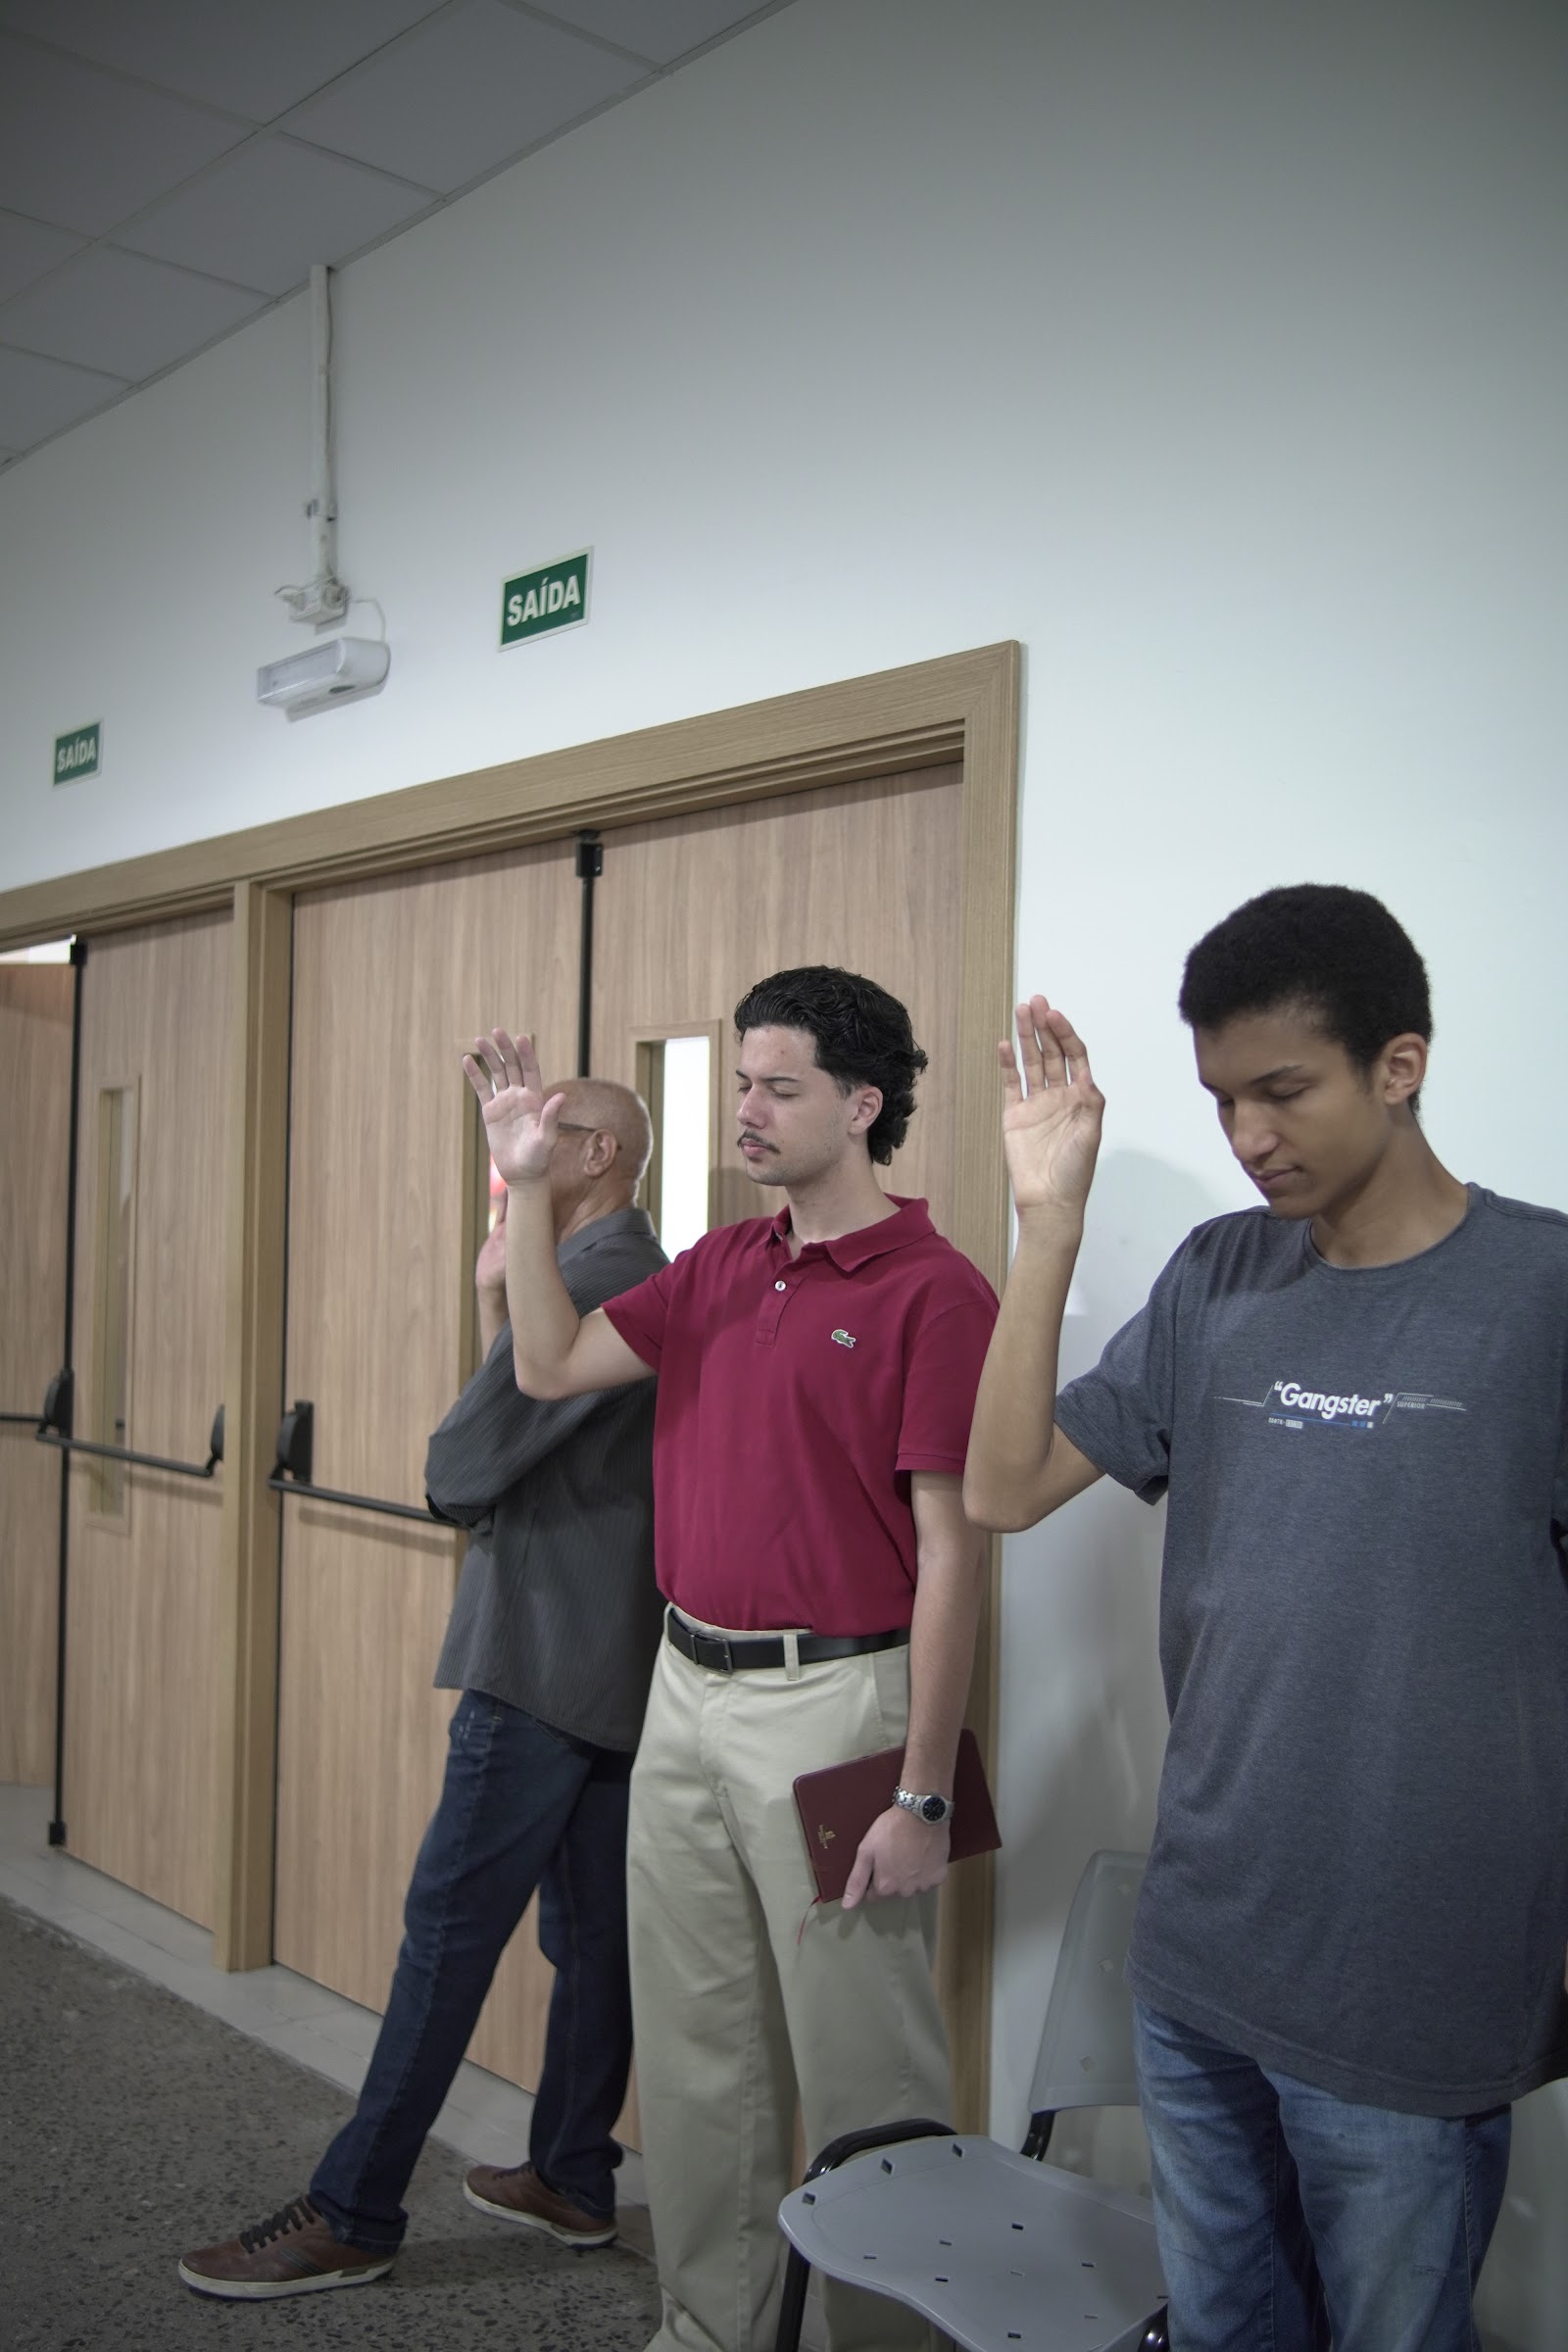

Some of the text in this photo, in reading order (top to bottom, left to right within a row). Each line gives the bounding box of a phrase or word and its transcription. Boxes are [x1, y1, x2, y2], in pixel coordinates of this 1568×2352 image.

[507, 574, 581, 627] SAÍDA
[57, 737, 96, 773] SAÍDA
[1396, 1400, 1426, 1409] SUPERIOR
